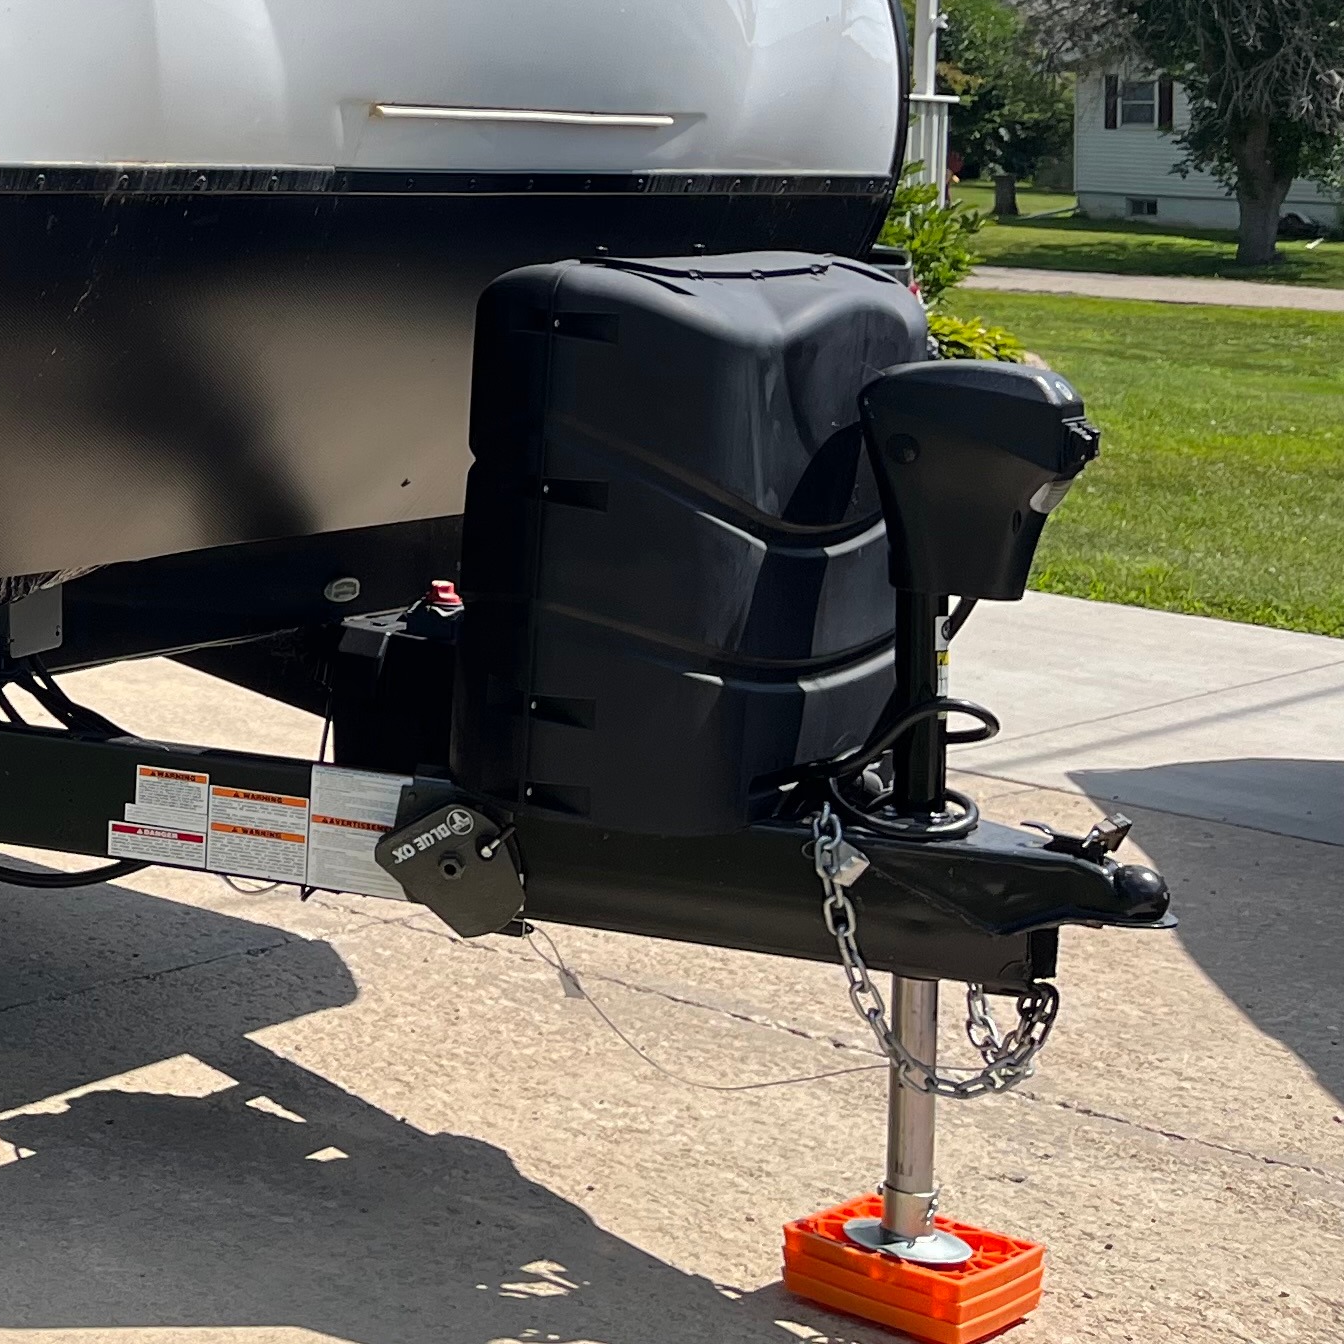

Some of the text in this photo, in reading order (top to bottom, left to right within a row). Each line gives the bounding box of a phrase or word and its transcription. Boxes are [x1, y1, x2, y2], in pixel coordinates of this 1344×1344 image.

[156, 769, 196, 783] WARNING
[243, 792, 283, 804] WARNING
[143, 828, 179, 840] DANGER
[242, 827, 282, 840] WARNING
[392, 823, 451, 865] BLUE OX
